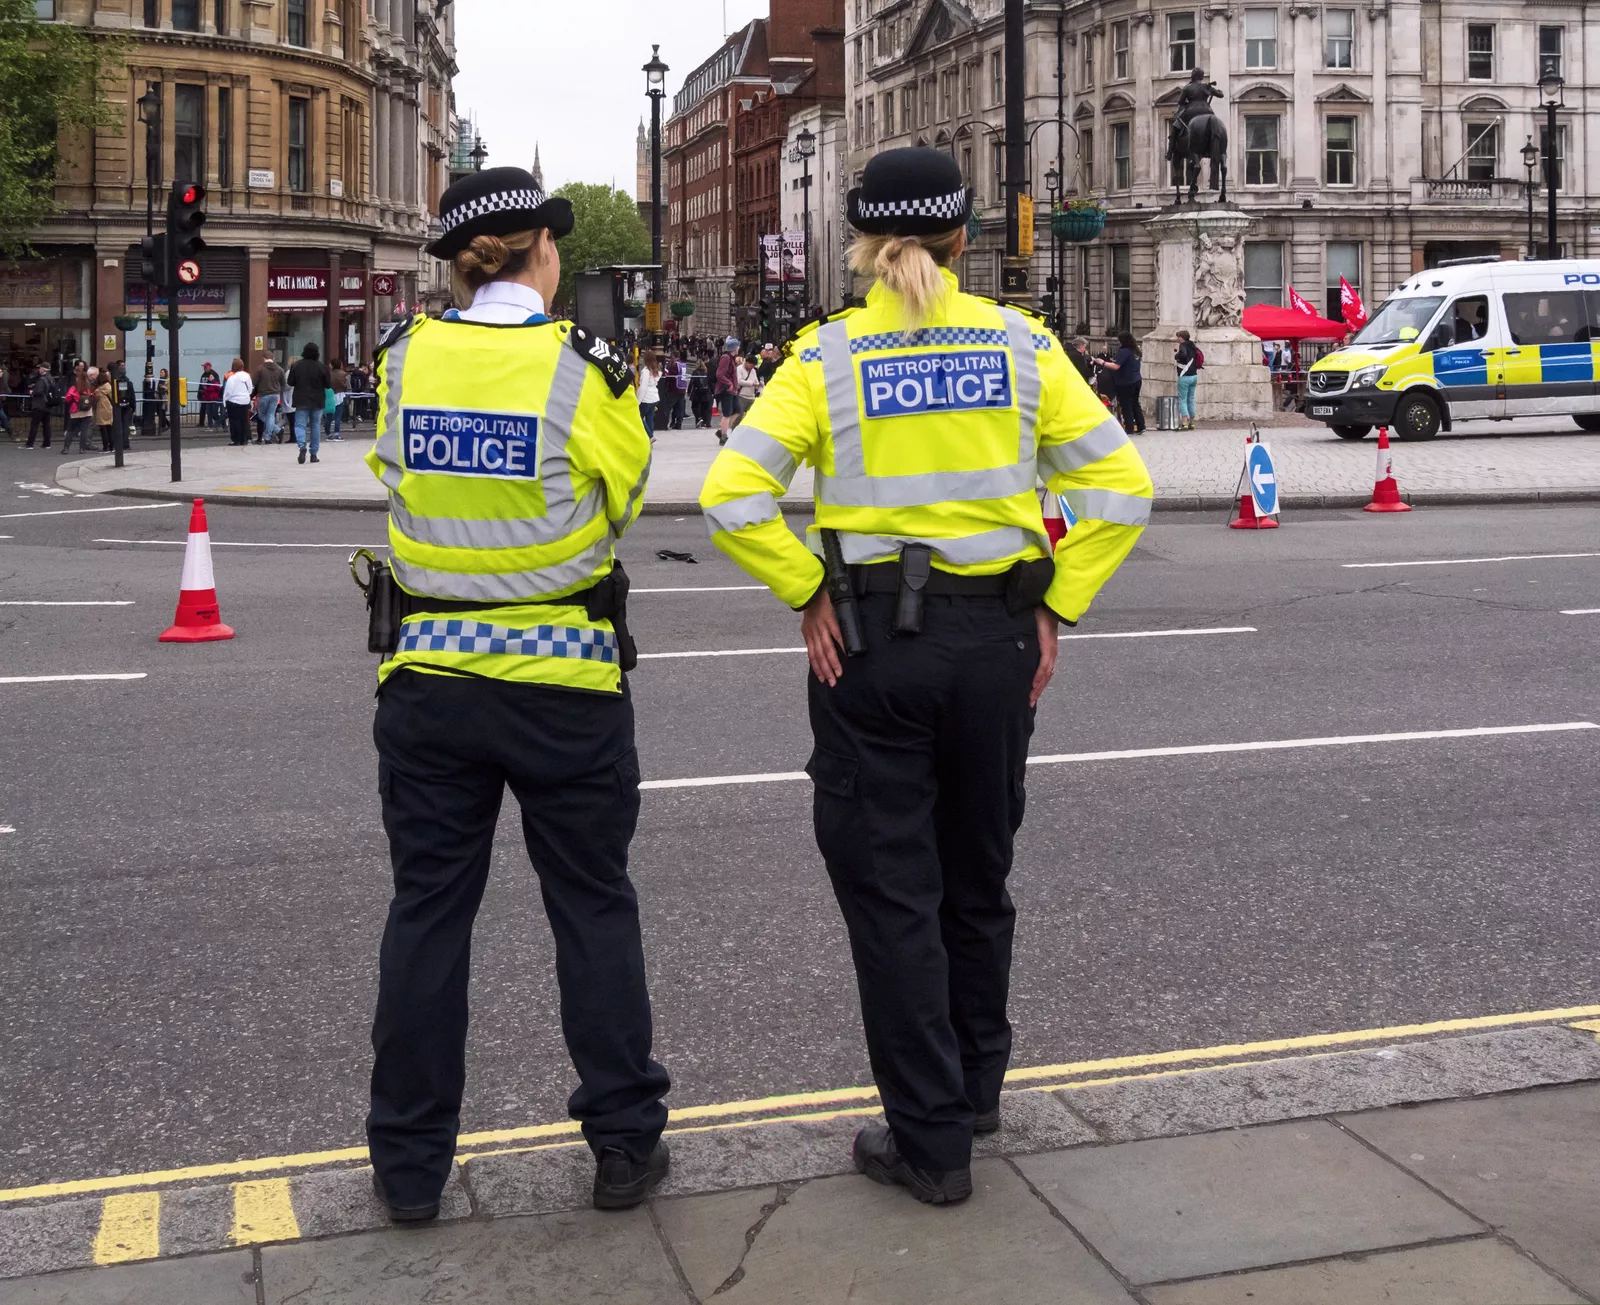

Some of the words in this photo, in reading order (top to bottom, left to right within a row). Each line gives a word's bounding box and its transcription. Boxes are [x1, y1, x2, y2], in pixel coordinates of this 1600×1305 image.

[784, 241, 804, 249] KILLE
[794, 248, 804, 256] JO
[277, 276, 290, 290] PRET
[291, 276, 296, 290] A
[296, 276, 318, 290] MANGER
[177, 288, 225, 300] express
[867, 356, 1002, 378] METROPOLITAN
[869, 373, 1005, 411] POLICE
[409, 415, 528, 436] METROPOLITAN
[409, 433, 526, 471] POLICE
